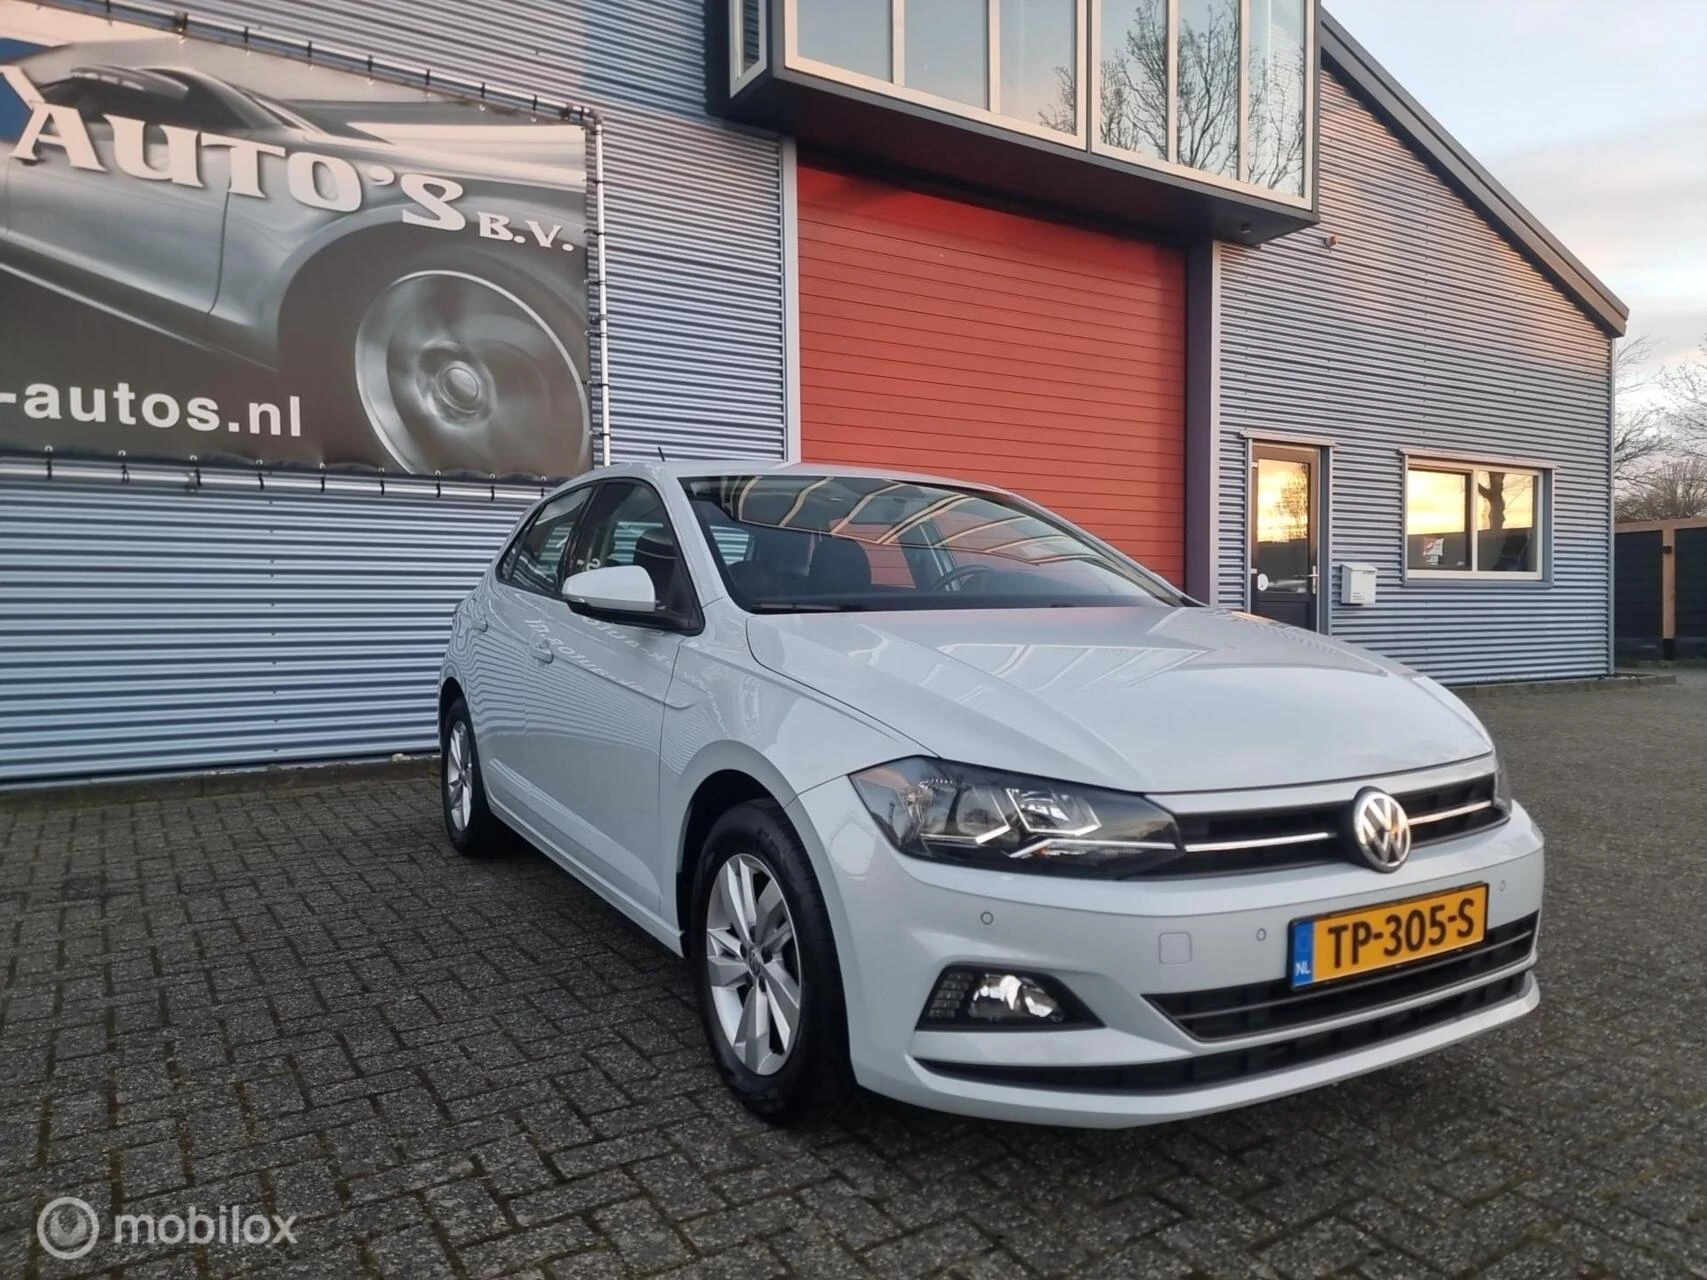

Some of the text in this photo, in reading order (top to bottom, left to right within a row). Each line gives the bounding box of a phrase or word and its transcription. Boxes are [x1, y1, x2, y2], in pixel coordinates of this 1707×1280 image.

[477, 211, 575, 251] B.V.
[1328, 898, 1475, 968] TP-305-S
[1295, 961, 1311, 976] NL
